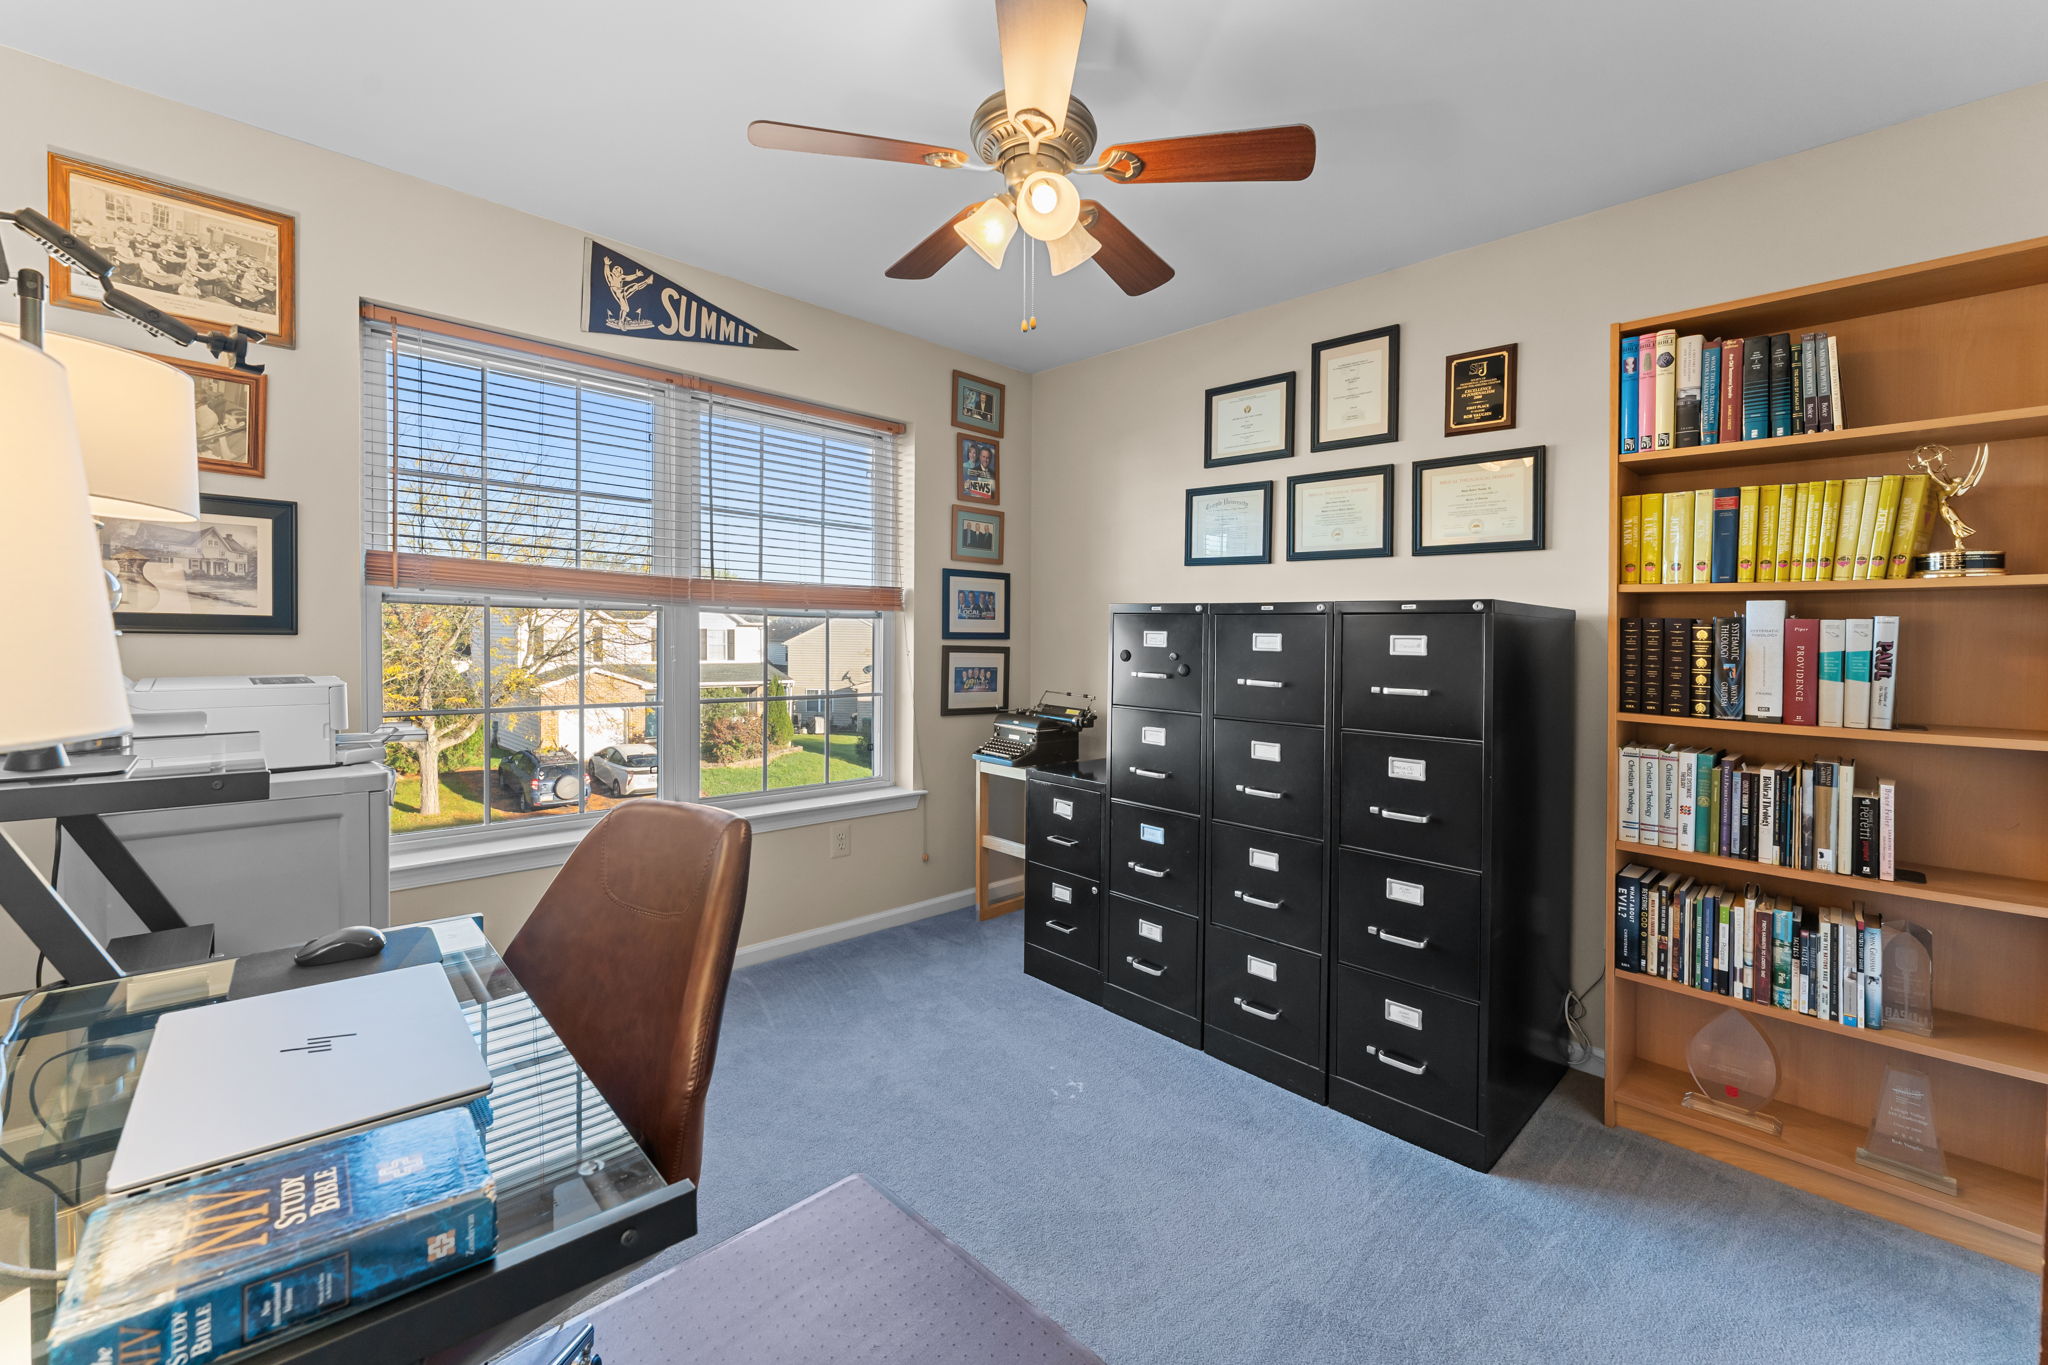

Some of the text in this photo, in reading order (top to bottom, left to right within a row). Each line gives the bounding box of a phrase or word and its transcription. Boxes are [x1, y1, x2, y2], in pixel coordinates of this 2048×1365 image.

[658, 287, 758, 345] SUMMIT
[970, 481, 991, 493] NEWS
[1623, 519, 1633, 546] MARK
[1643, 517, 1654, 544] LUKE
[1876, 508, 1889, 531] JOHN
[1720, 624, 1730, 659] THEOLOGY
[1731, 623, 1740, 661] SYSTEMATIC
[1795, 645, 1805, 702] PROVIDENCE
[1873, 640, 1894, 682] PAUL
[1720, 681, 1729, 707] GRUDEM
[1730, 684, 1739, 704] WAYNE
[1627, 759, 1635, 787] Christian
[1646, 761, 1654, 789] Christian
[1665, 763, 1673, 791] Christian
[1627, 788, 1635, 816] Theology
[1645, 790, 1653, 817] Theology
[1664, 793, 1673, 820] Theology
[1760, 775, 1772, 827] Biblical Theology
[1884, 788, 1893, 807] Bruce
[1859, 806, 1871, 840] Peretti
[1618, 887, 1628, 918] EVIL?
[1869, 931, 1878, 946] JOHN
[1777, 972, 1786, 984] Pink
[274, 1174, 307, 1230] STUDY
[309, 1165, 341, 1218] BIBLE
[171, 1188, 272, 1265] NIV
[165, 1311, 189, 1365] STUDY
[190, 1302, 213, 1359] BIBLE
